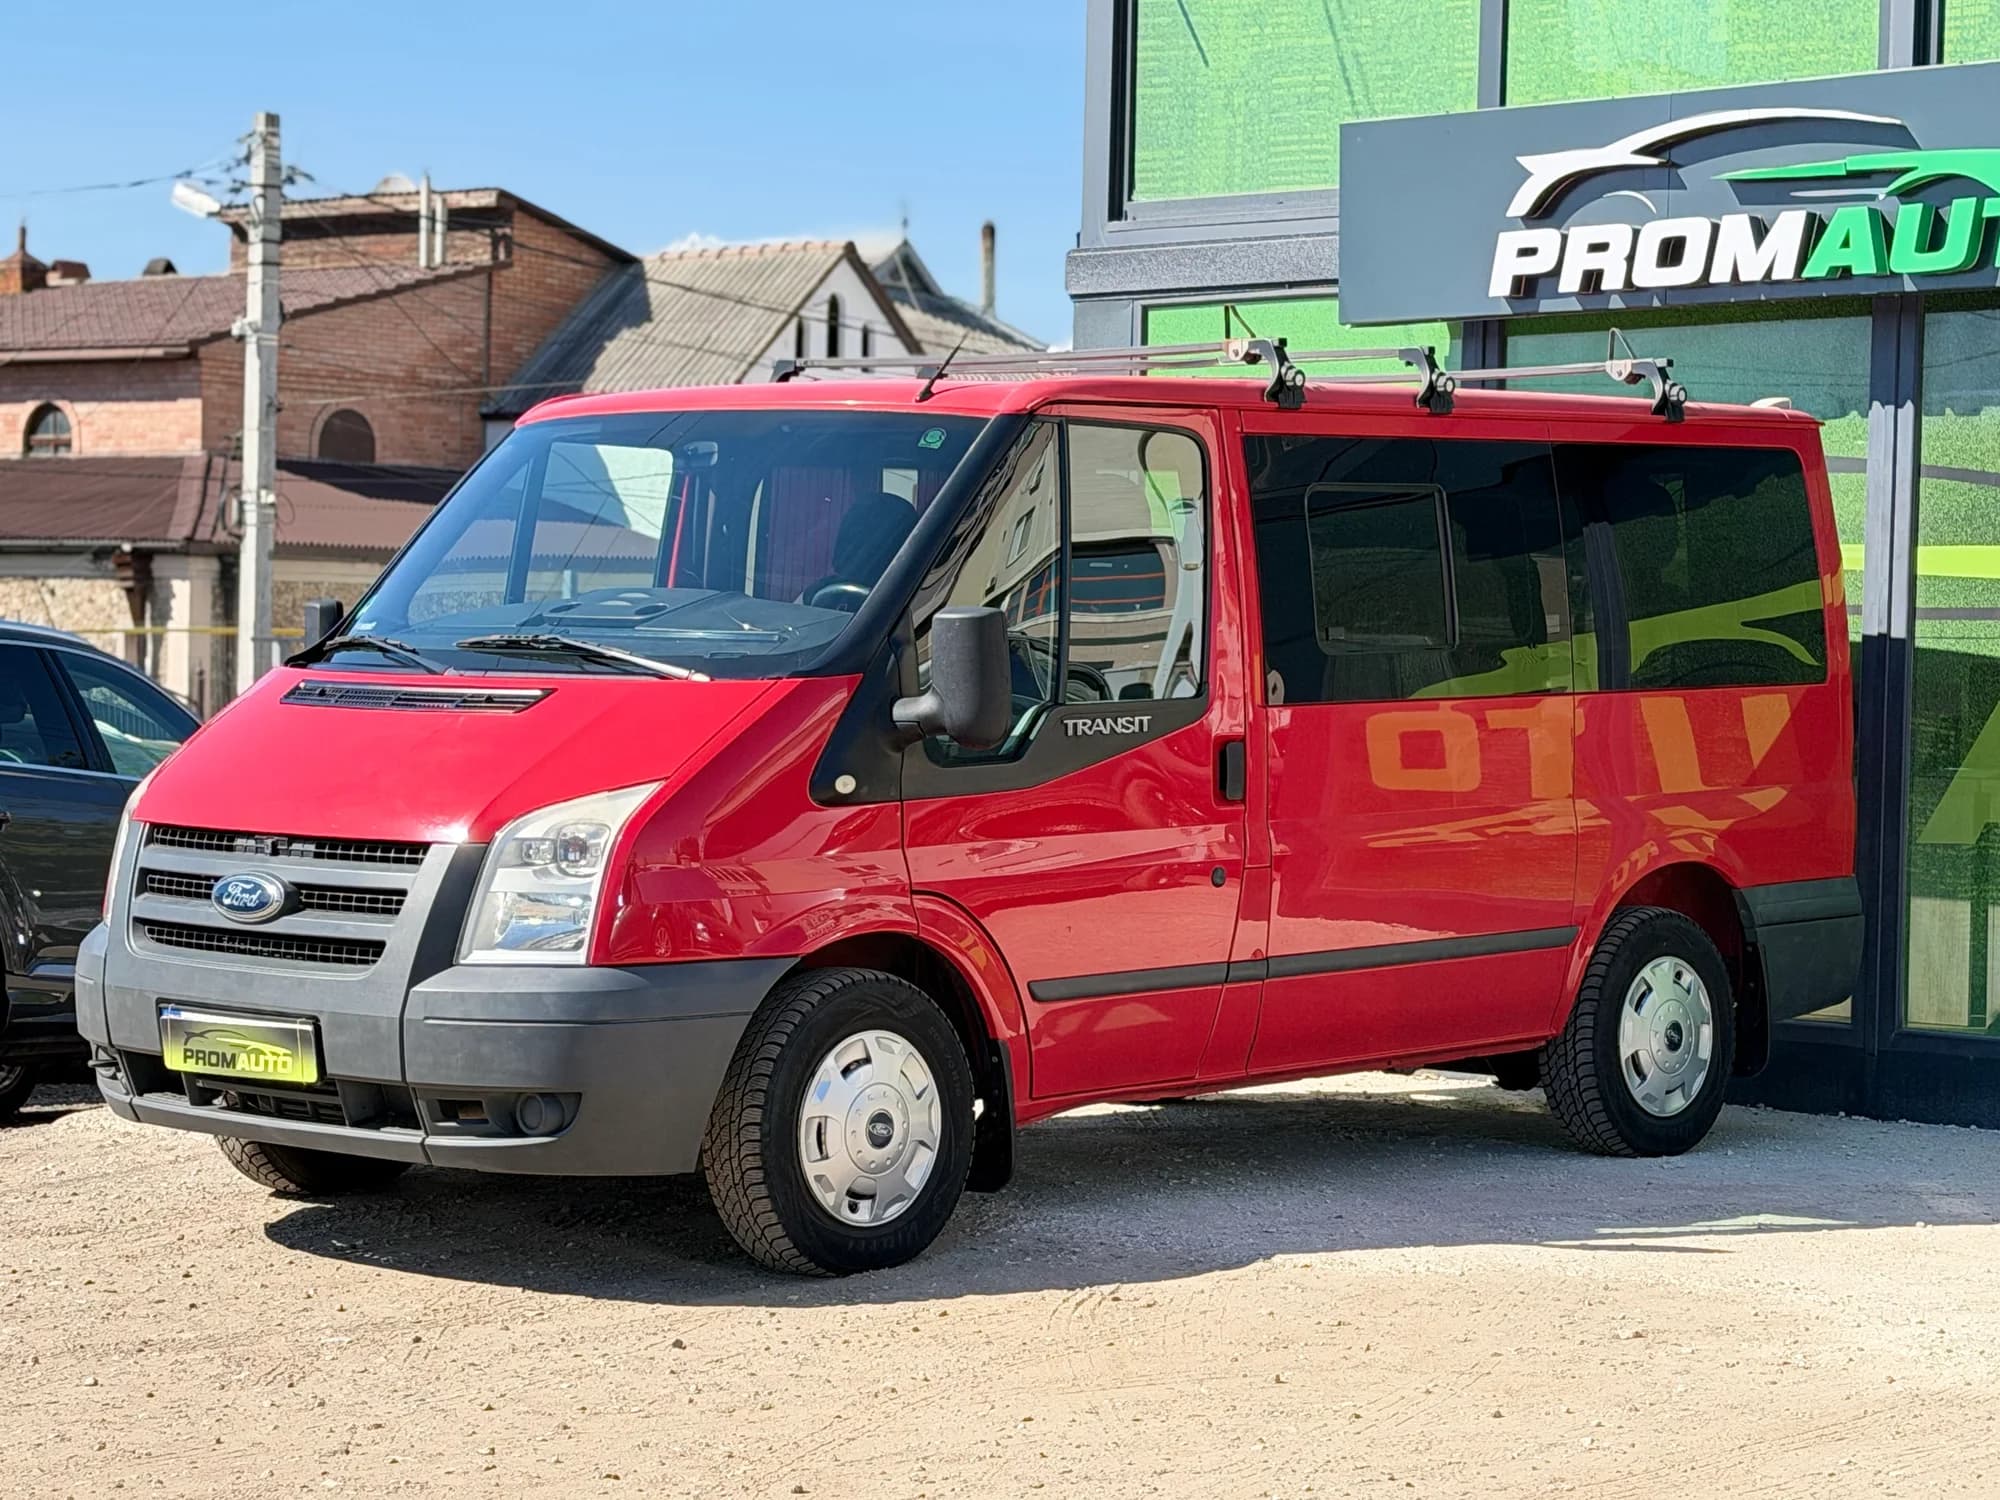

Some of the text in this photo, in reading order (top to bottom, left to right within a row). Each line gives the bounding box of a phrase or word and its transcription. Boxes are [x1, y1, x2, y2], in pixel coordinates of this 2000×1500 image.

[1488, 196, 2000, 298] PROMAU
[1063, 715, 1152, 737] TRANSIT
[222, 881, 262, 908] Ford
[183, 1047, 294, 1074] PROMAUTO
